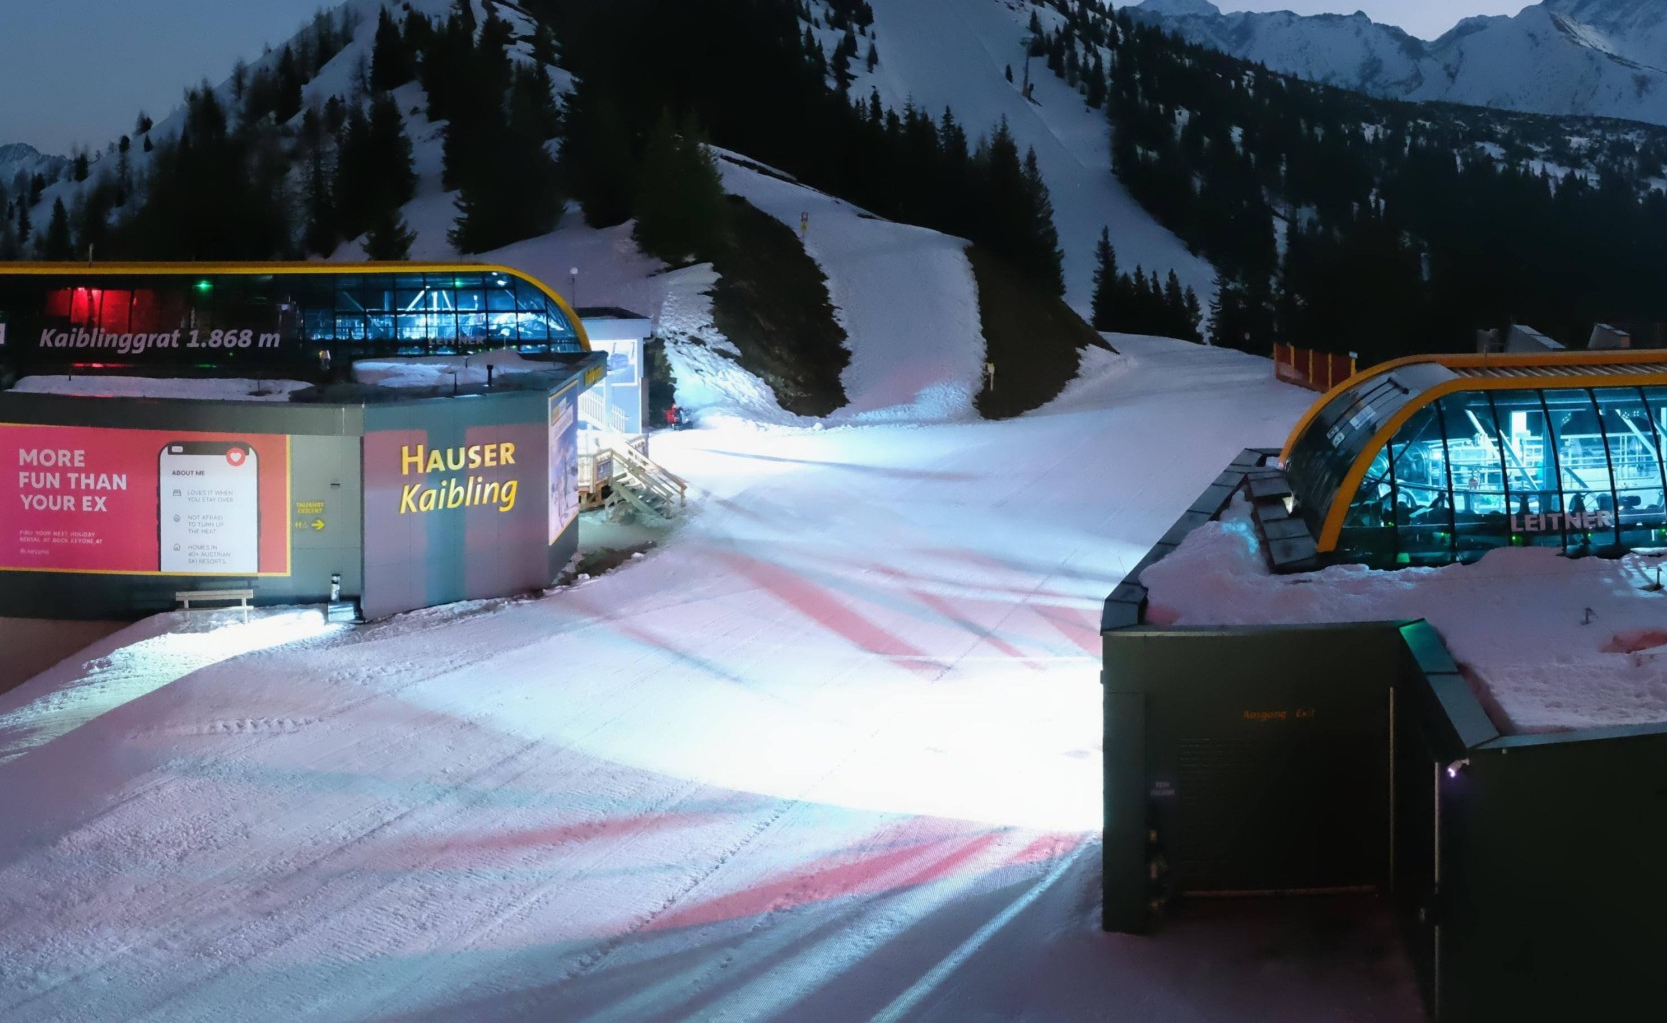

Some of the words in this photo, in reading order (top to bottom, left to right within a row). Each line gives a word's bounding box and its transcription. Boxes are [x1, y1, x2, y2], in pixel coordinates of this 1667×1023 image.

[39, 328, 180, 354] Kaiblinggrat
[186, 329, 252, 348] 1.868
[258, 333, 281, 348] m
[19, 449, 85, 467] MORE
[401, 442, 516, 475] HAUSER
[19, 471, 60, 489] FUN
[67, 472, 127, 490] THAN
[20, 494, 76, 511] YOUR
[82, 496, 107, 512] EX
[399, 476, 518, 514] Kaibling
[1510, 510, 1613, 532] LEITNER
